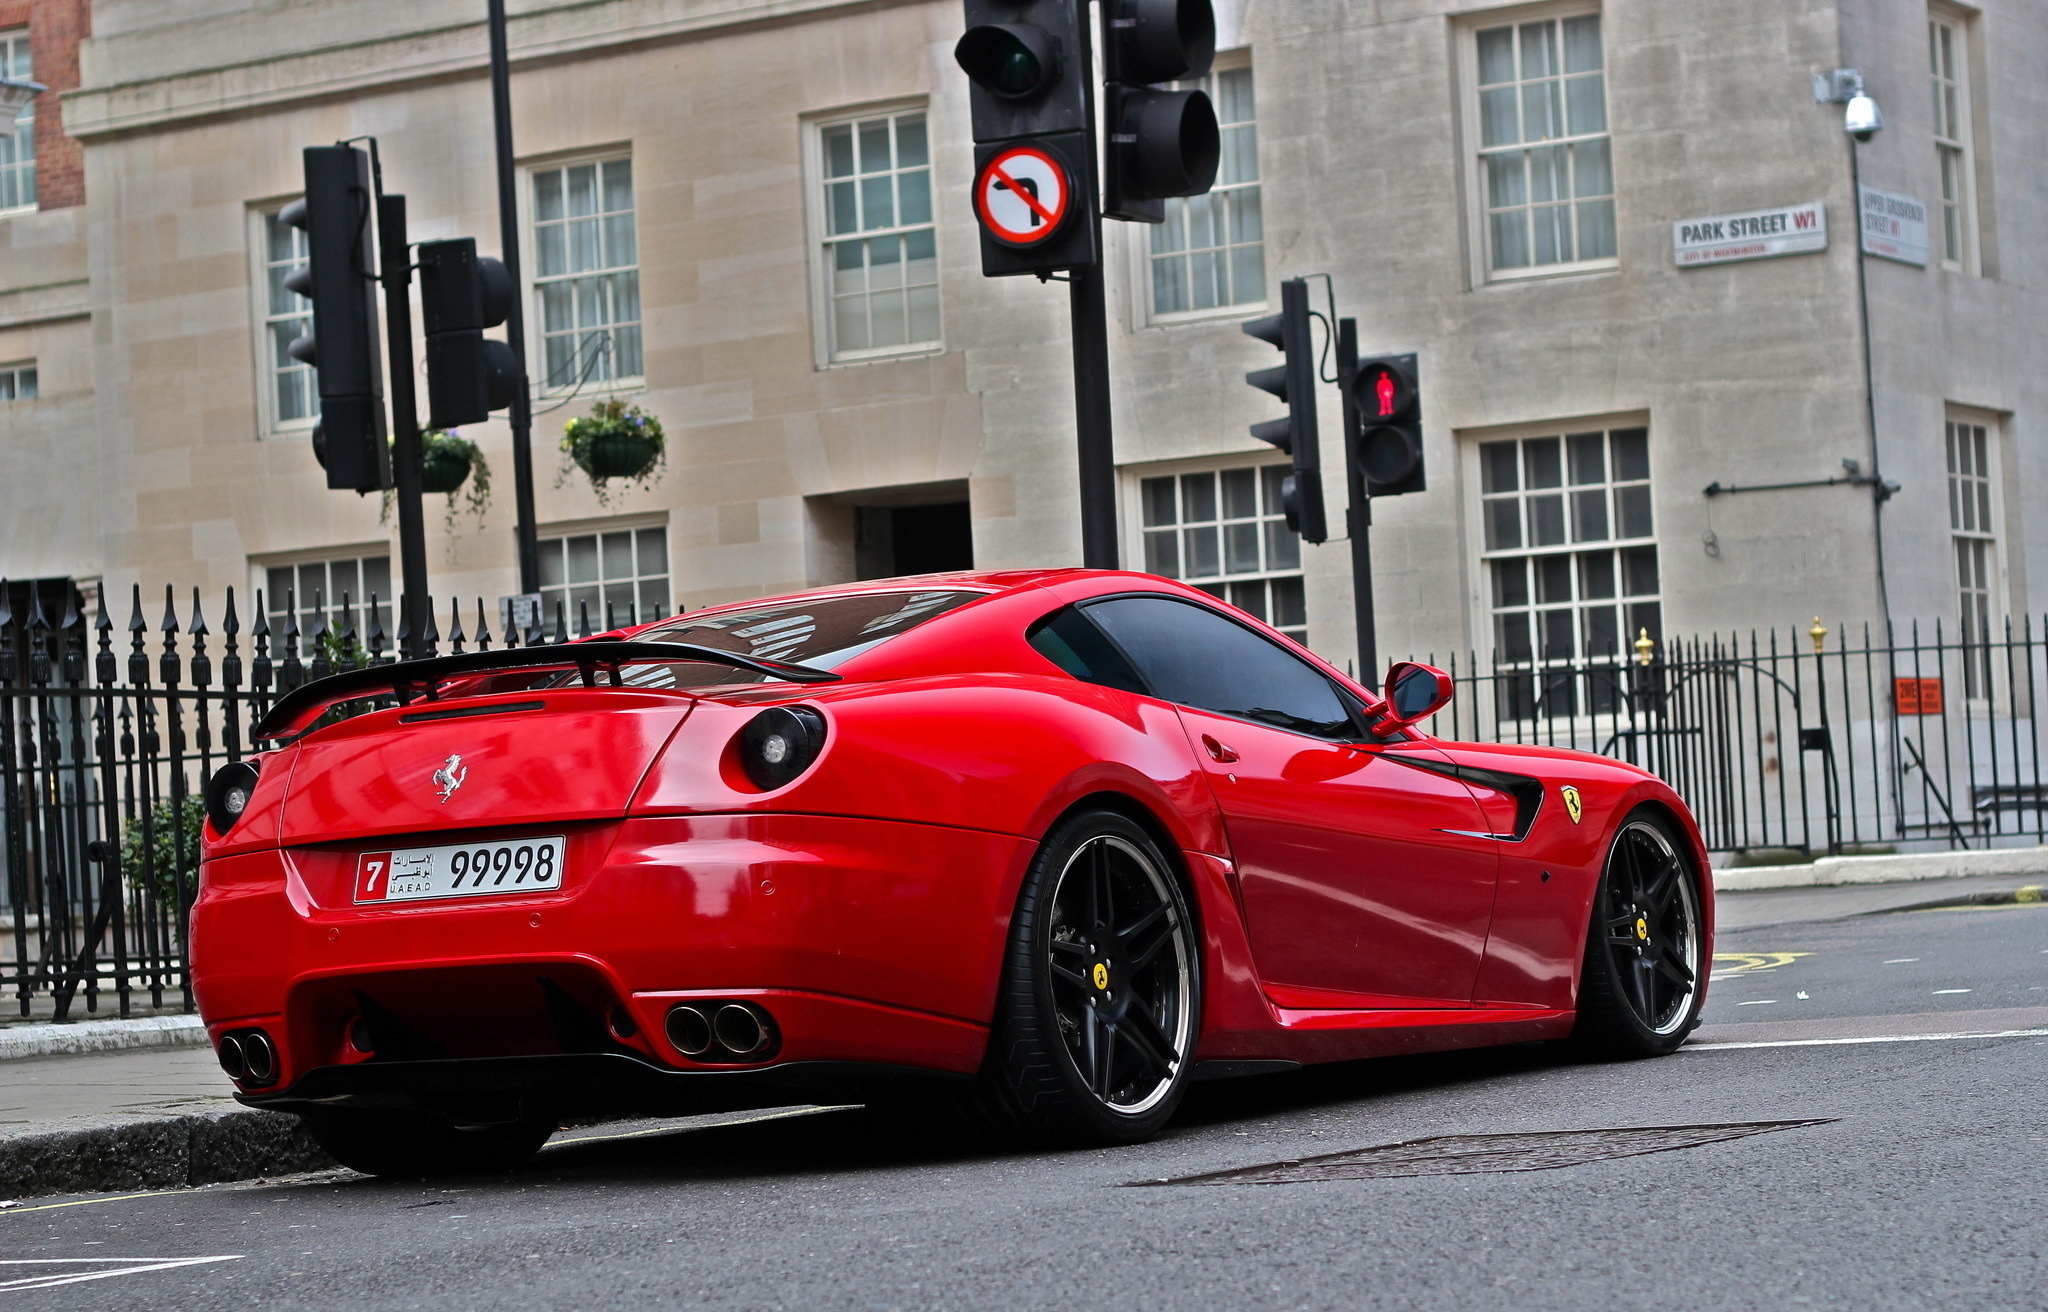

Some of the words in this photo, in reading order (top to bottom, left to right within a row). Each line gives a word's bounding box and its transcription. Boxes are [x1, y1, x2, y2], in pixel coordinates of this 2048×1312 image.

[1864, 191, 1885, 213] UPPER
[1681, 221, 1724, 243] PARK
[1729, 213, 1788, 237] STREET
[1864, 212, 1889, 235] STREET
[1684, 251, 1700, 261] CITY
[366, 861, 384, 892] 7
[450, 843, 555, 889] 99998
